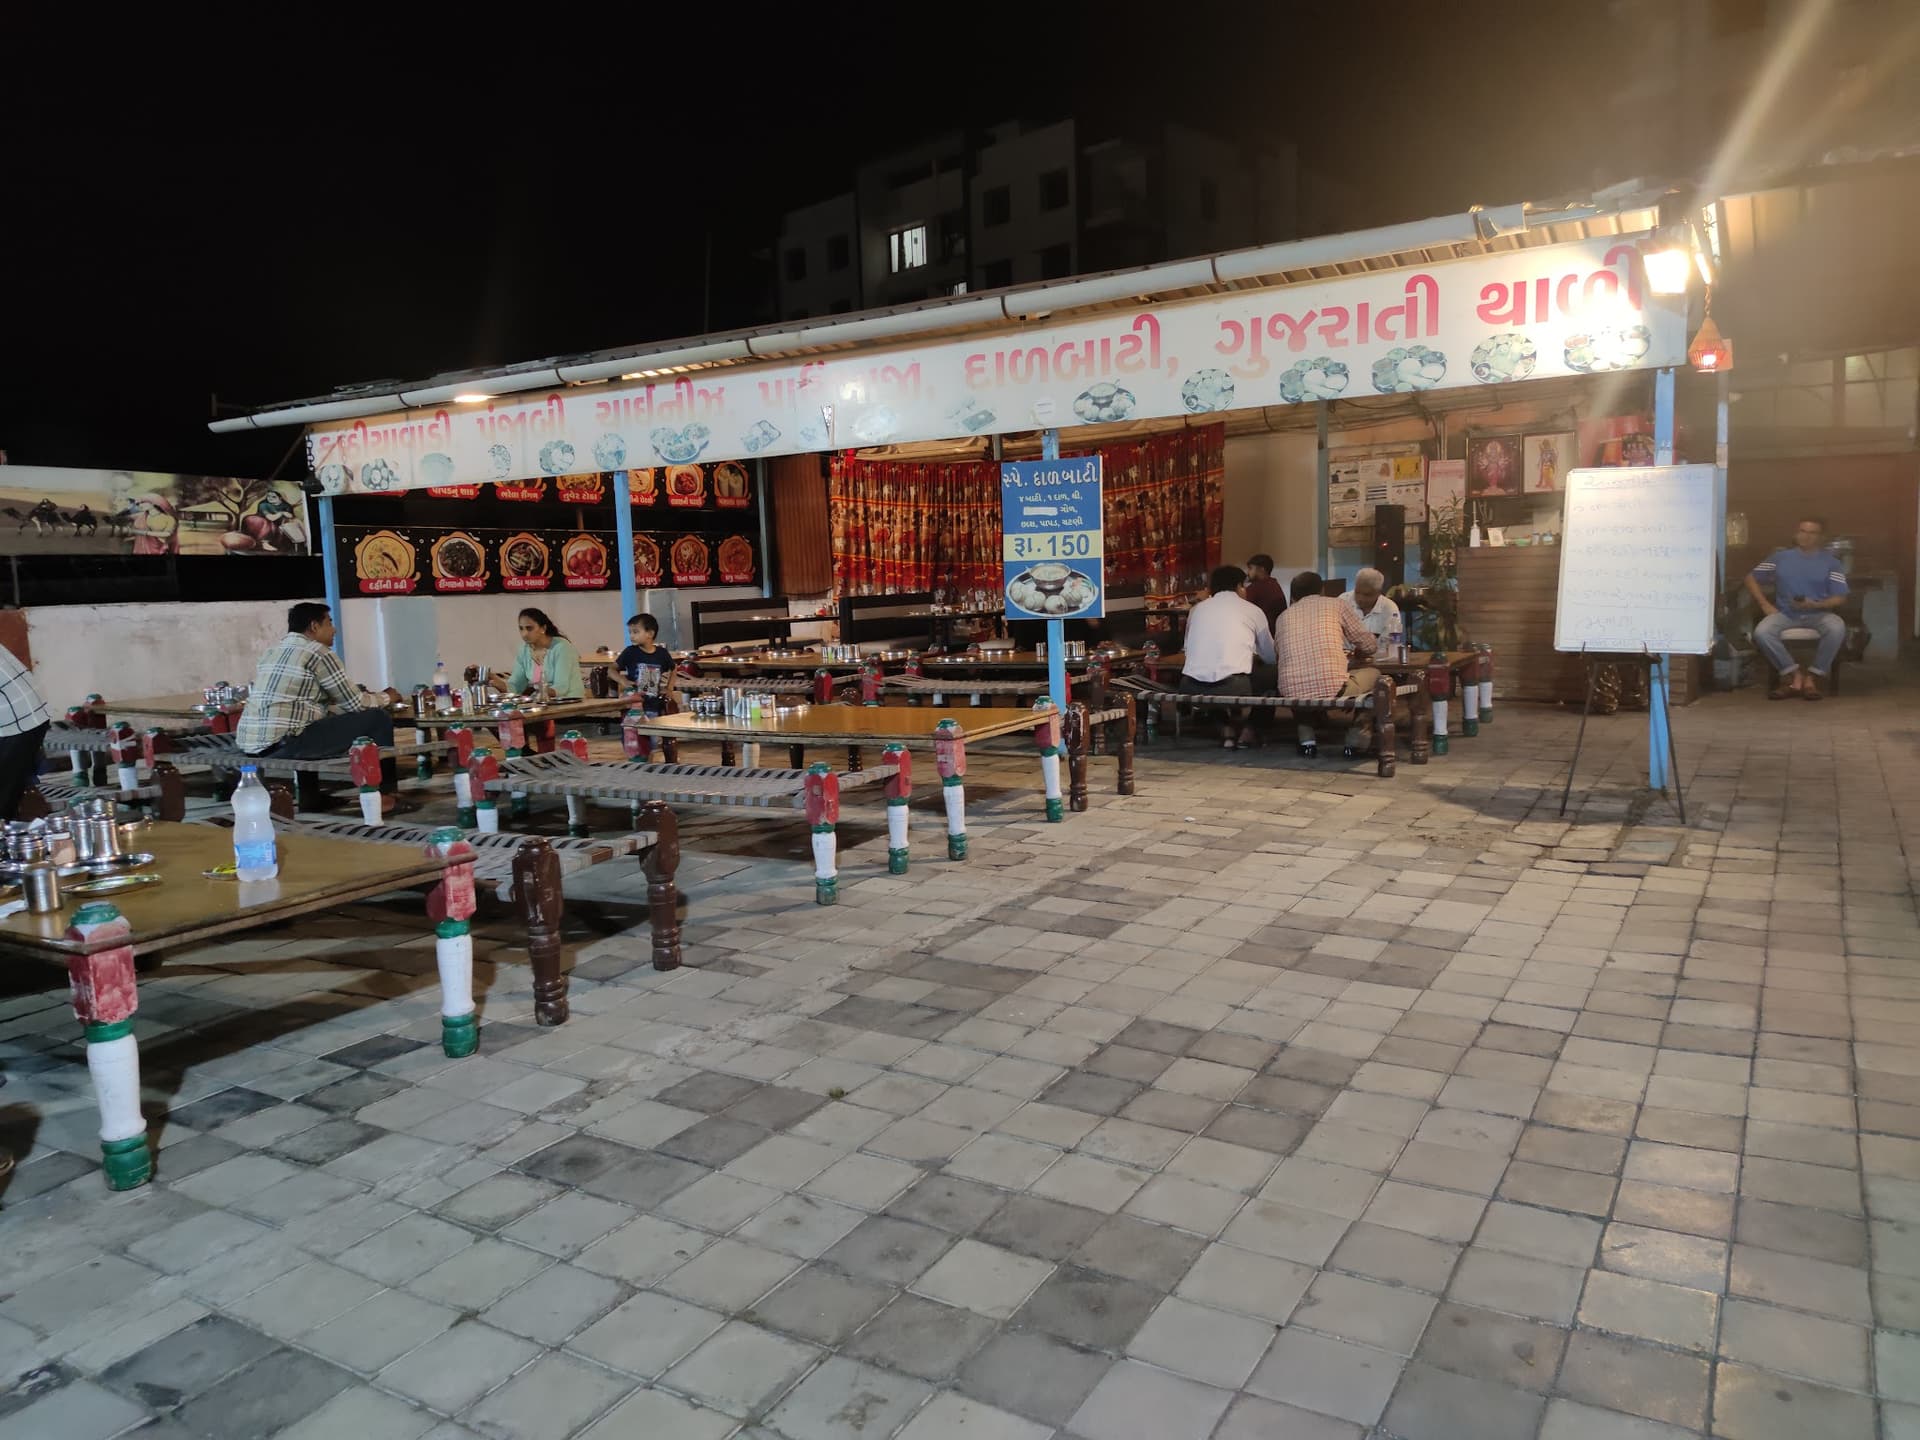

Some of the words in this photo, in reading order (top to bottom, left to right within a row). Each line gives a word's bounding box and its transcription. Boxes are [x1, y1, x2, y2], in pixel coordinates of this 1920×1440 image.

[1214, 273, 1440, 380] ગુજરાતી
[1475, 244, 1643, 328] થાળી
[1047, 533, 1090, 557] 150
